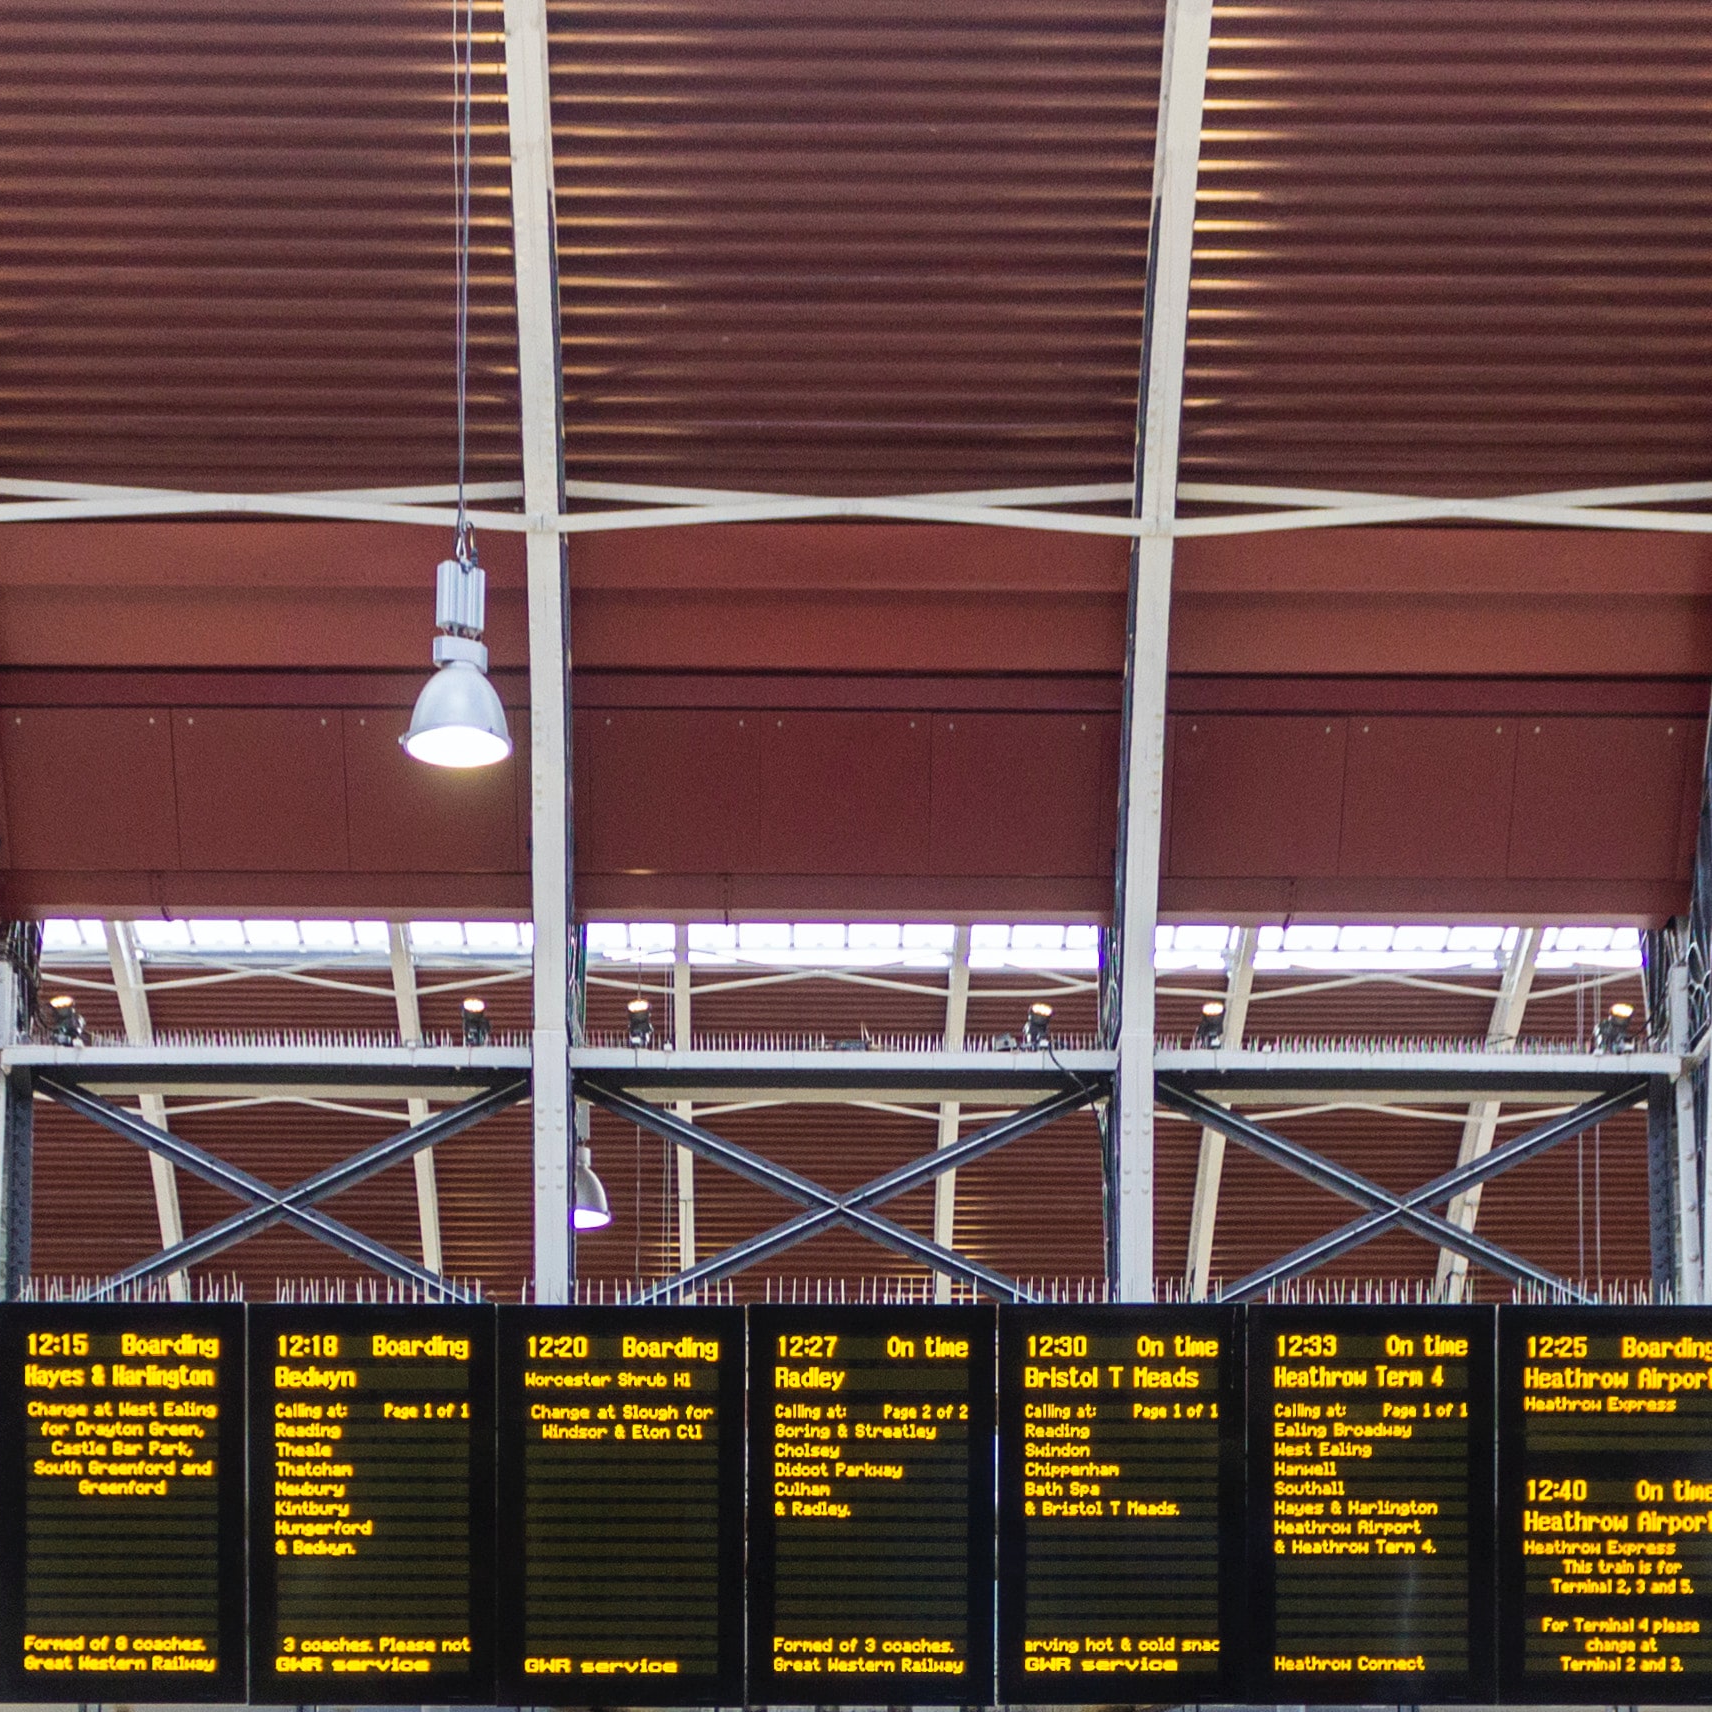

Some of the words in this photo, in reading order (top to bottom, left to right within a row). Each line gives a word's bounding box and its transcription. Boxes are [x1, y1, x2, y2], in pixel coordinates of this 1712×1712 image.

[28, 1333, 89, 1356] 12:15
[122, 1334, 219, 1359] Boarding
[278, 1335, 339, 1357] 12:18
[373, 1335, 469, 1360] Boarding
[528, 1336, 588, 1358] 12:20
[623, 1336, 718, 1362] Boarding
[779, 1336, 838, 1357] 12:27
[887, 1336, 914, 1357] On
[925, 1336, 968, 1358] time
[1028, 1336, 1087, 1357] 12:30
[1137, 1336, 1164, 1357] On
[1174, 1336, 1218, 1357] time
[1278, 1335, 1337, 1357] 12:33
[1385, 1335, 1413, 1356] On
[1423, 1335, 1468, 1356] time
[1528, 1336, 1587, 1358] 12:25
[25, 1364, 85, 1389] Hayes
[91, 1364, 105, 1386] &
[112, 1365, 215, 1390] Harlington
[275, 1366, 357, 1390] Bedwyn
[525, 1372, 612, 1387] Worcester
[618, 1372, 667, 1387] Shrub
[775, 1367, 845, 1391] Radley
[1025, 1367, 1098, 1388] Bristol
[1108, 1367, 1124, 1388] T
[1133, 1366, 1199, 1388] Meads
[1274, 1366, 1367, 1388] Heathrow
[1375, 1365, 1423, 1387] Term
[1431, 1365, 1444, 1387] 4
[1524, 1367, 1628, 1389] Heathrow
[531, 1405, 590, 1421] Change
[597, 1405, 616, 1419] at
[623, 1405, 679, 1421] Slough
[686, 1405, 713, 1420] for
[543, 1424, 608, 1439] Windsor
[615, 1424, 626, 1439] &
[632, 1424, 671, 1439] Eton
[775, 1424, 831, 1440] Goring
[837, 1424, 848, 1438] &
[855, 1424, 936, 1440] Streatley
[1025, 1423, 1090, 1439] Reading
[1275, 1422, 1327, 1438] Ealing
[1333, 1422, 1412, 1438] Broadway
[275, 1442, 332, 1457] Theale
[775, 1443, 840, 1459] Cholsey
[1025, 1443, 1090, 1457] Swindon
[1025, 1462, 1119, 1478] Chippenham
[1527, 1480, 1587, 1501] 12:40
[1635, 1480, 1663, 1501] On
[275, 1520, 373, 1536] Hungerford
[1274, 1520, 1351, 1534] Heathrow
[1357, 1520, 1421, 1536] Airport
[1524, 1511, 1628, 1532] Heathrow
[1275, 1656, 1351, 1671] Heathrow
[1358, 1656, 1425, 1671] Connect
